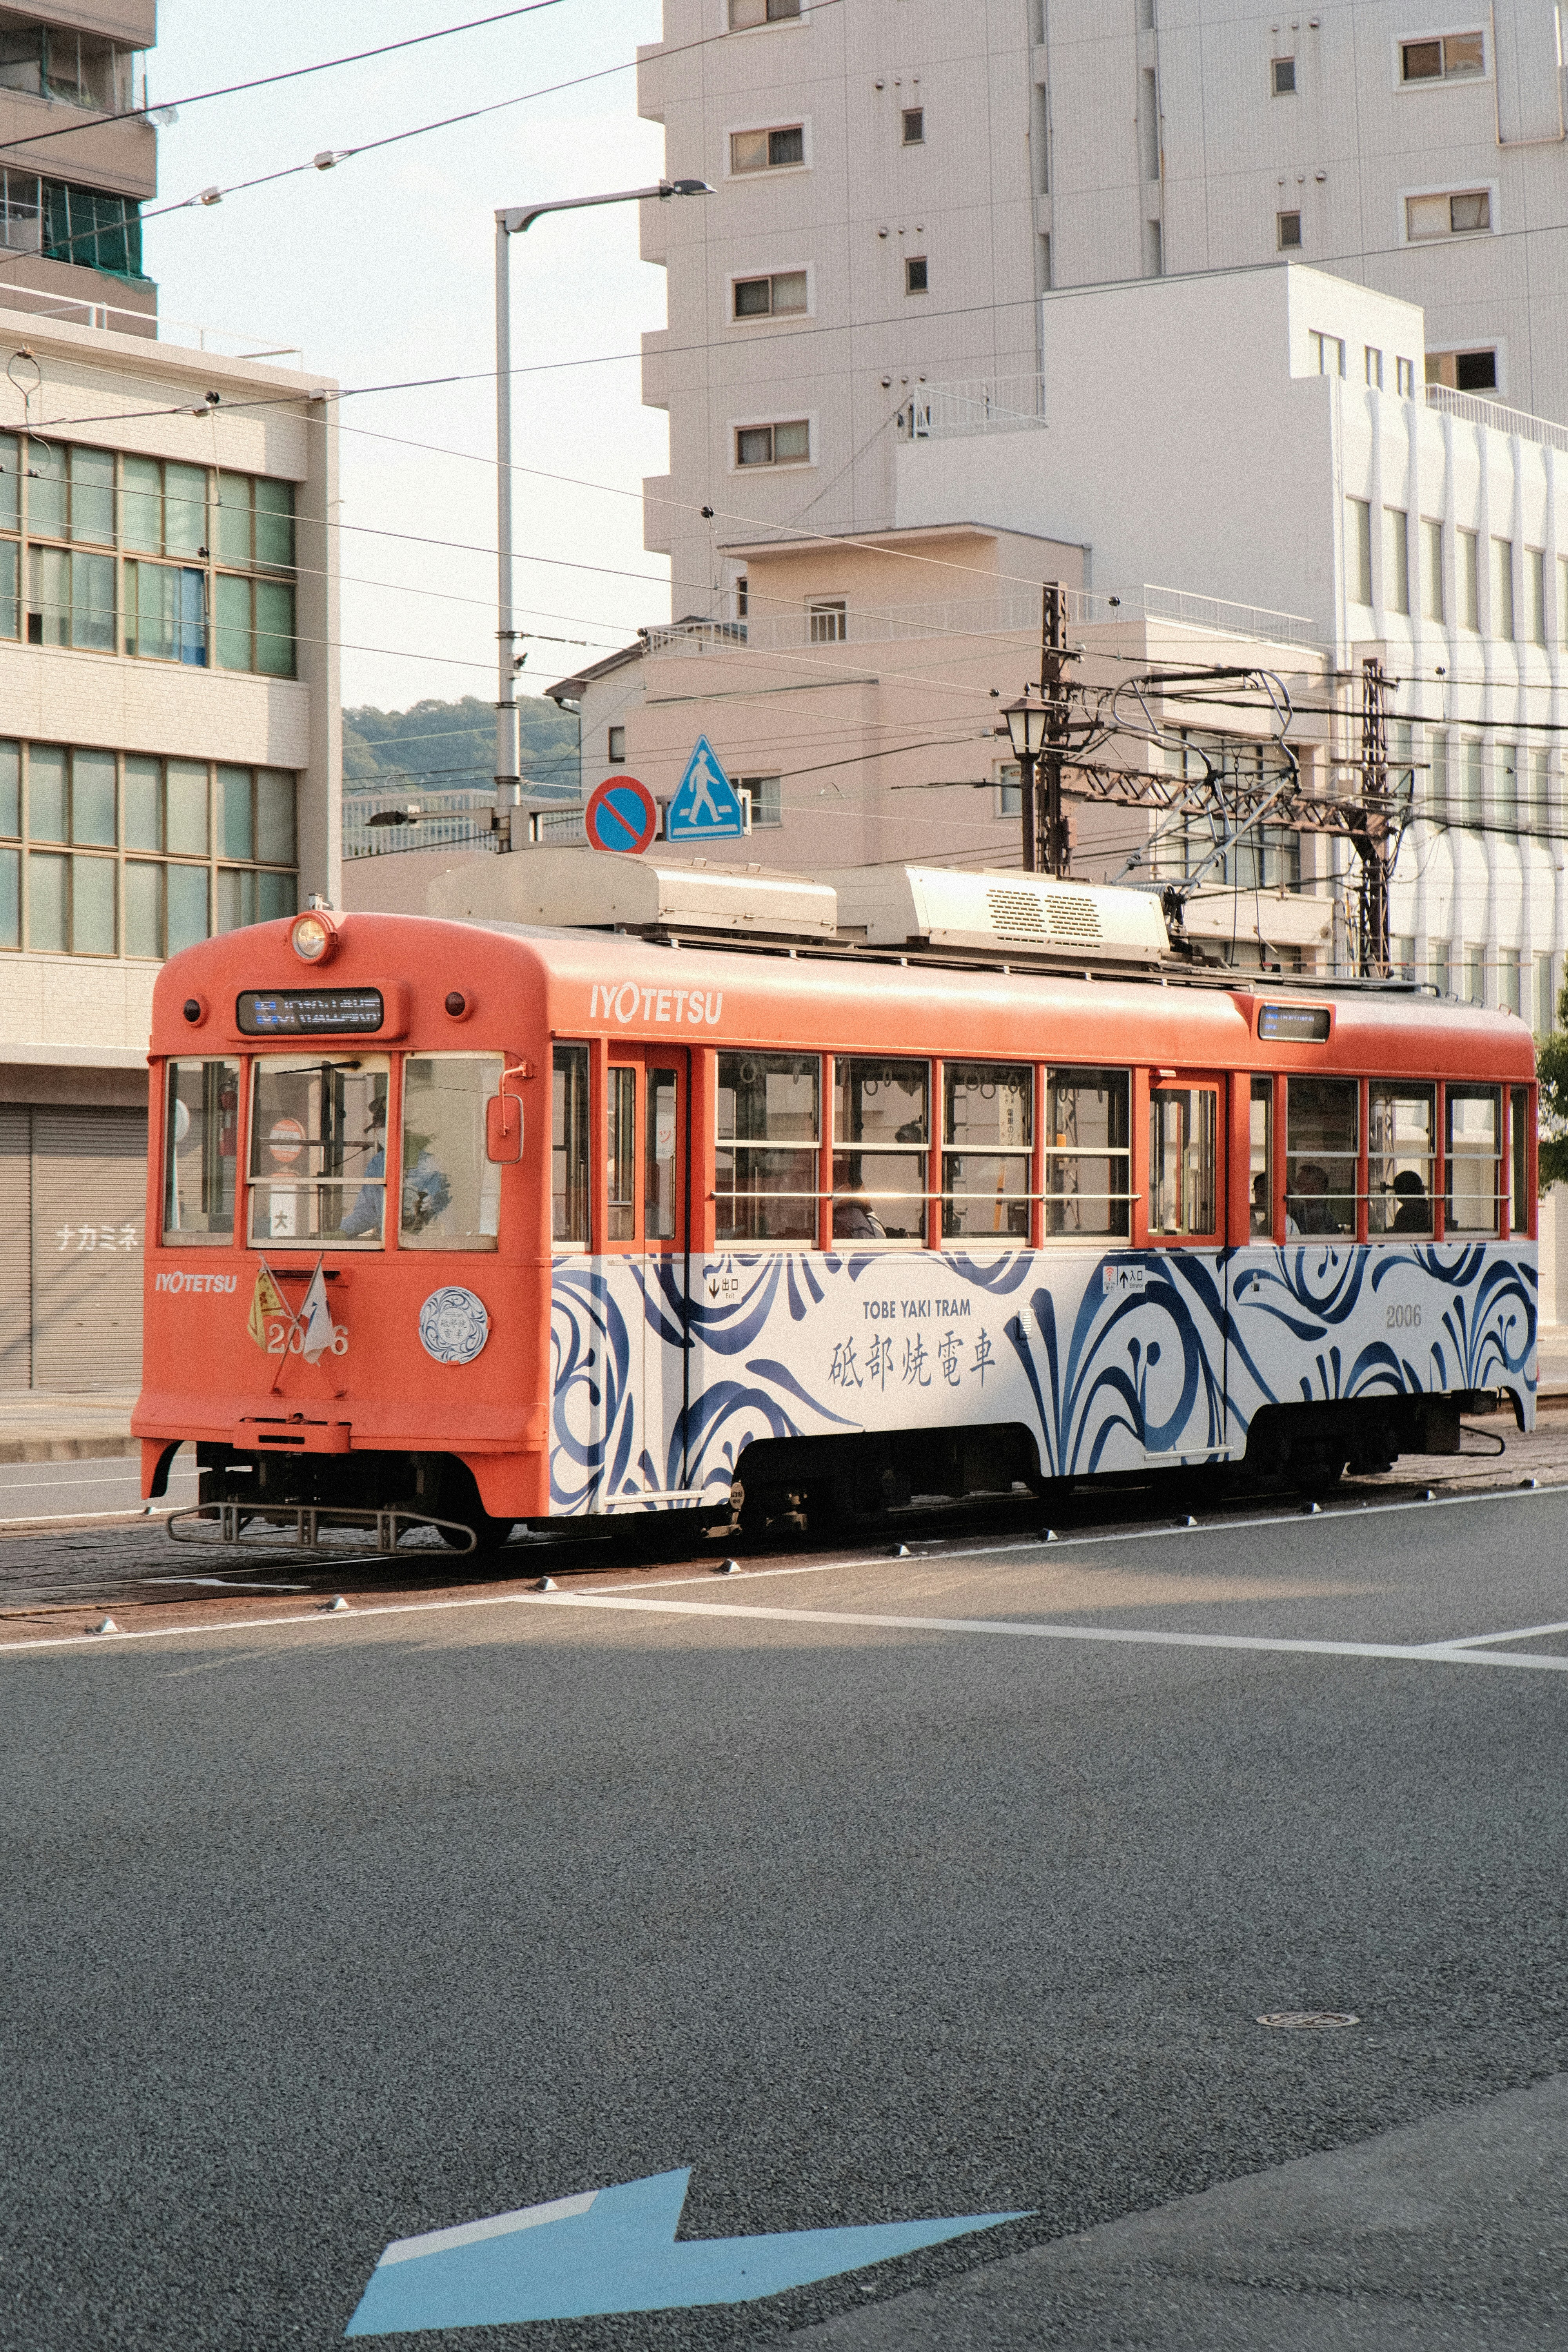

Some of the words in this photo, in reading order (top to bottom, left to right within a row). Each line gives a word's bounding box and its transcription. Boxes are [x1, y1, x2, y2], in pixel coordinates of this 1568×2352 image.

[590, 981, 723, 1024] IYOTETSU
[56, 1224, 138, 1251] ナカミネ
[155, 1270, 237, 1293] IYOTETSU
[722, 1278, 738, 1291] 出口
[1130, 1270, 1143, 1281] 入口
[862, 1301, 896, 1319] TOBE
[900, 1299, 931, 1318] YAKI
[935, 1298, 971, 1317] TRAM
[1387, 1304, 1421, 1328] 2006
[267, 1323, 348, 1355] 206
[828, 1327, 995, 1392] 砥部焼電車
